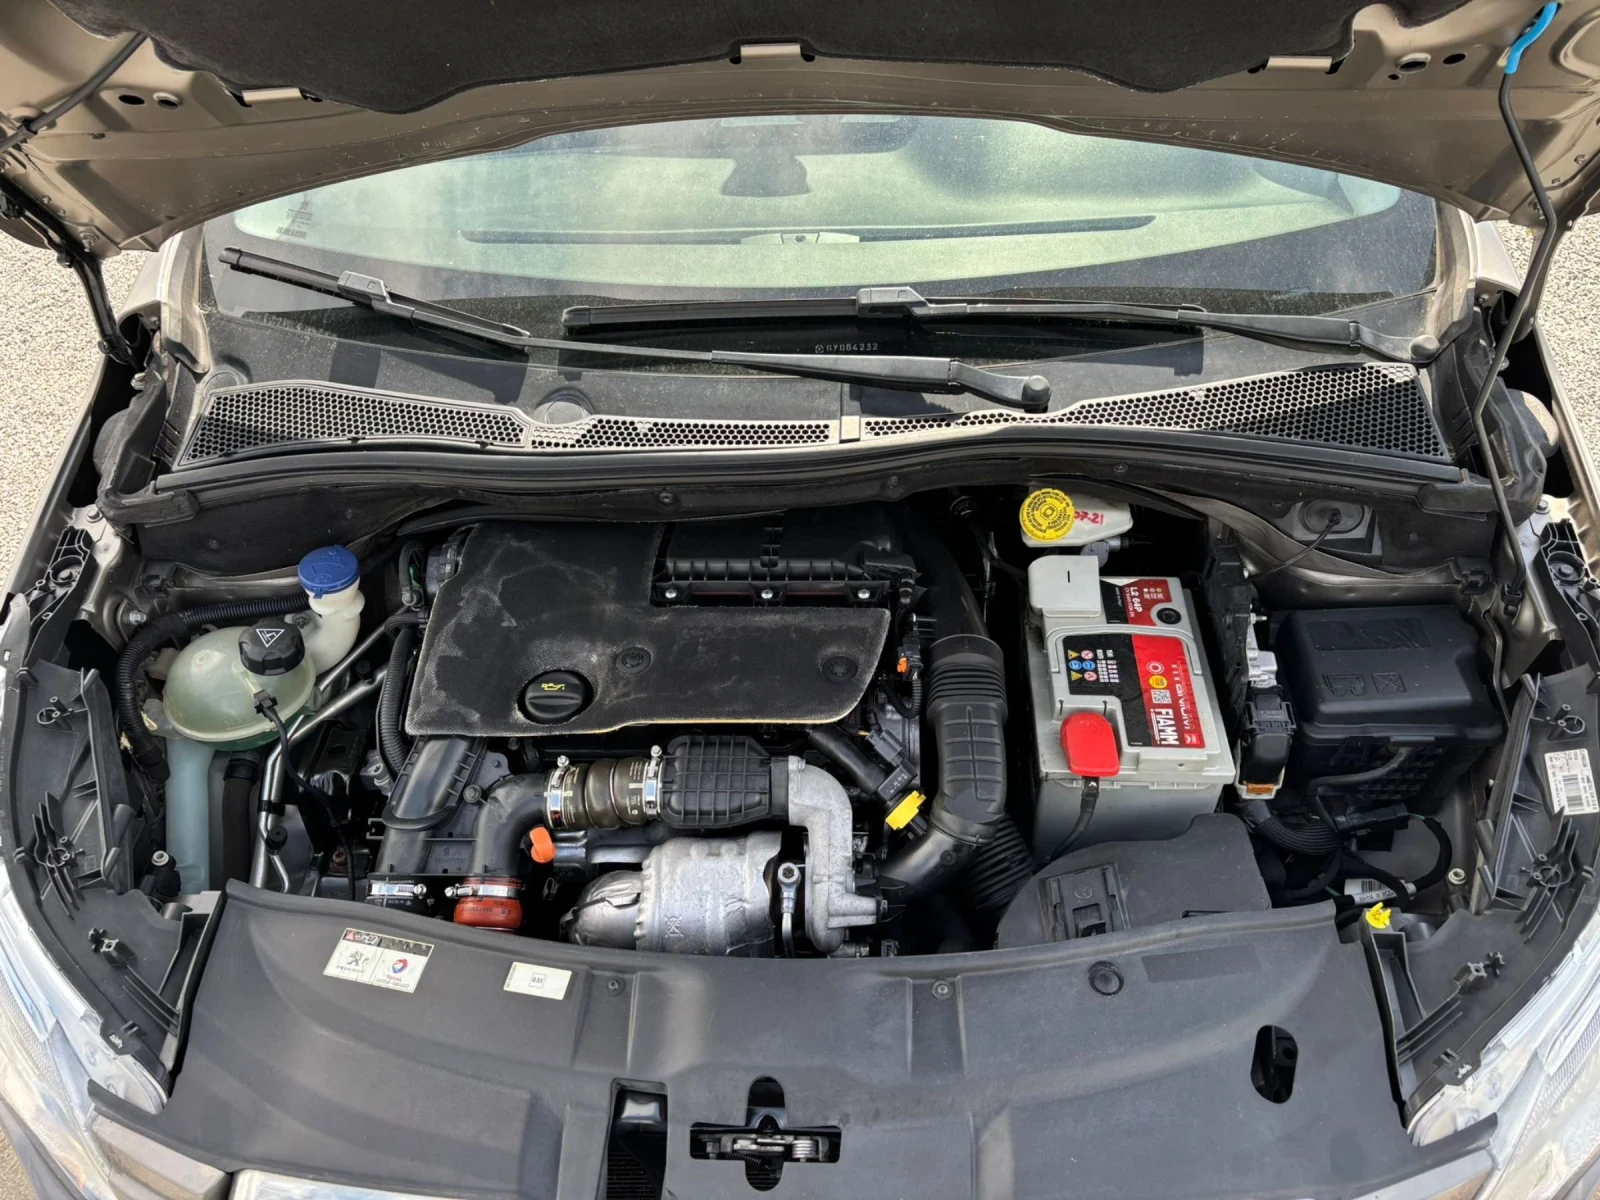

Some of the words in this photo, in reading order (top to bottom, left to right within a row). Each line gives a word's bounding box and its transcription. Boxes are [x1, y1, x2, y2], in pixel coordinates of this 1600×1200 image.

[1130, 586, 1139, 597] L2
[1132, 598, 1143, 612] 64P
[1154, 708, 1180, 745] FIAMM
[336, 965, 364, 974] PEUGEOT
[386, 974, 402, 982] TOTAL
